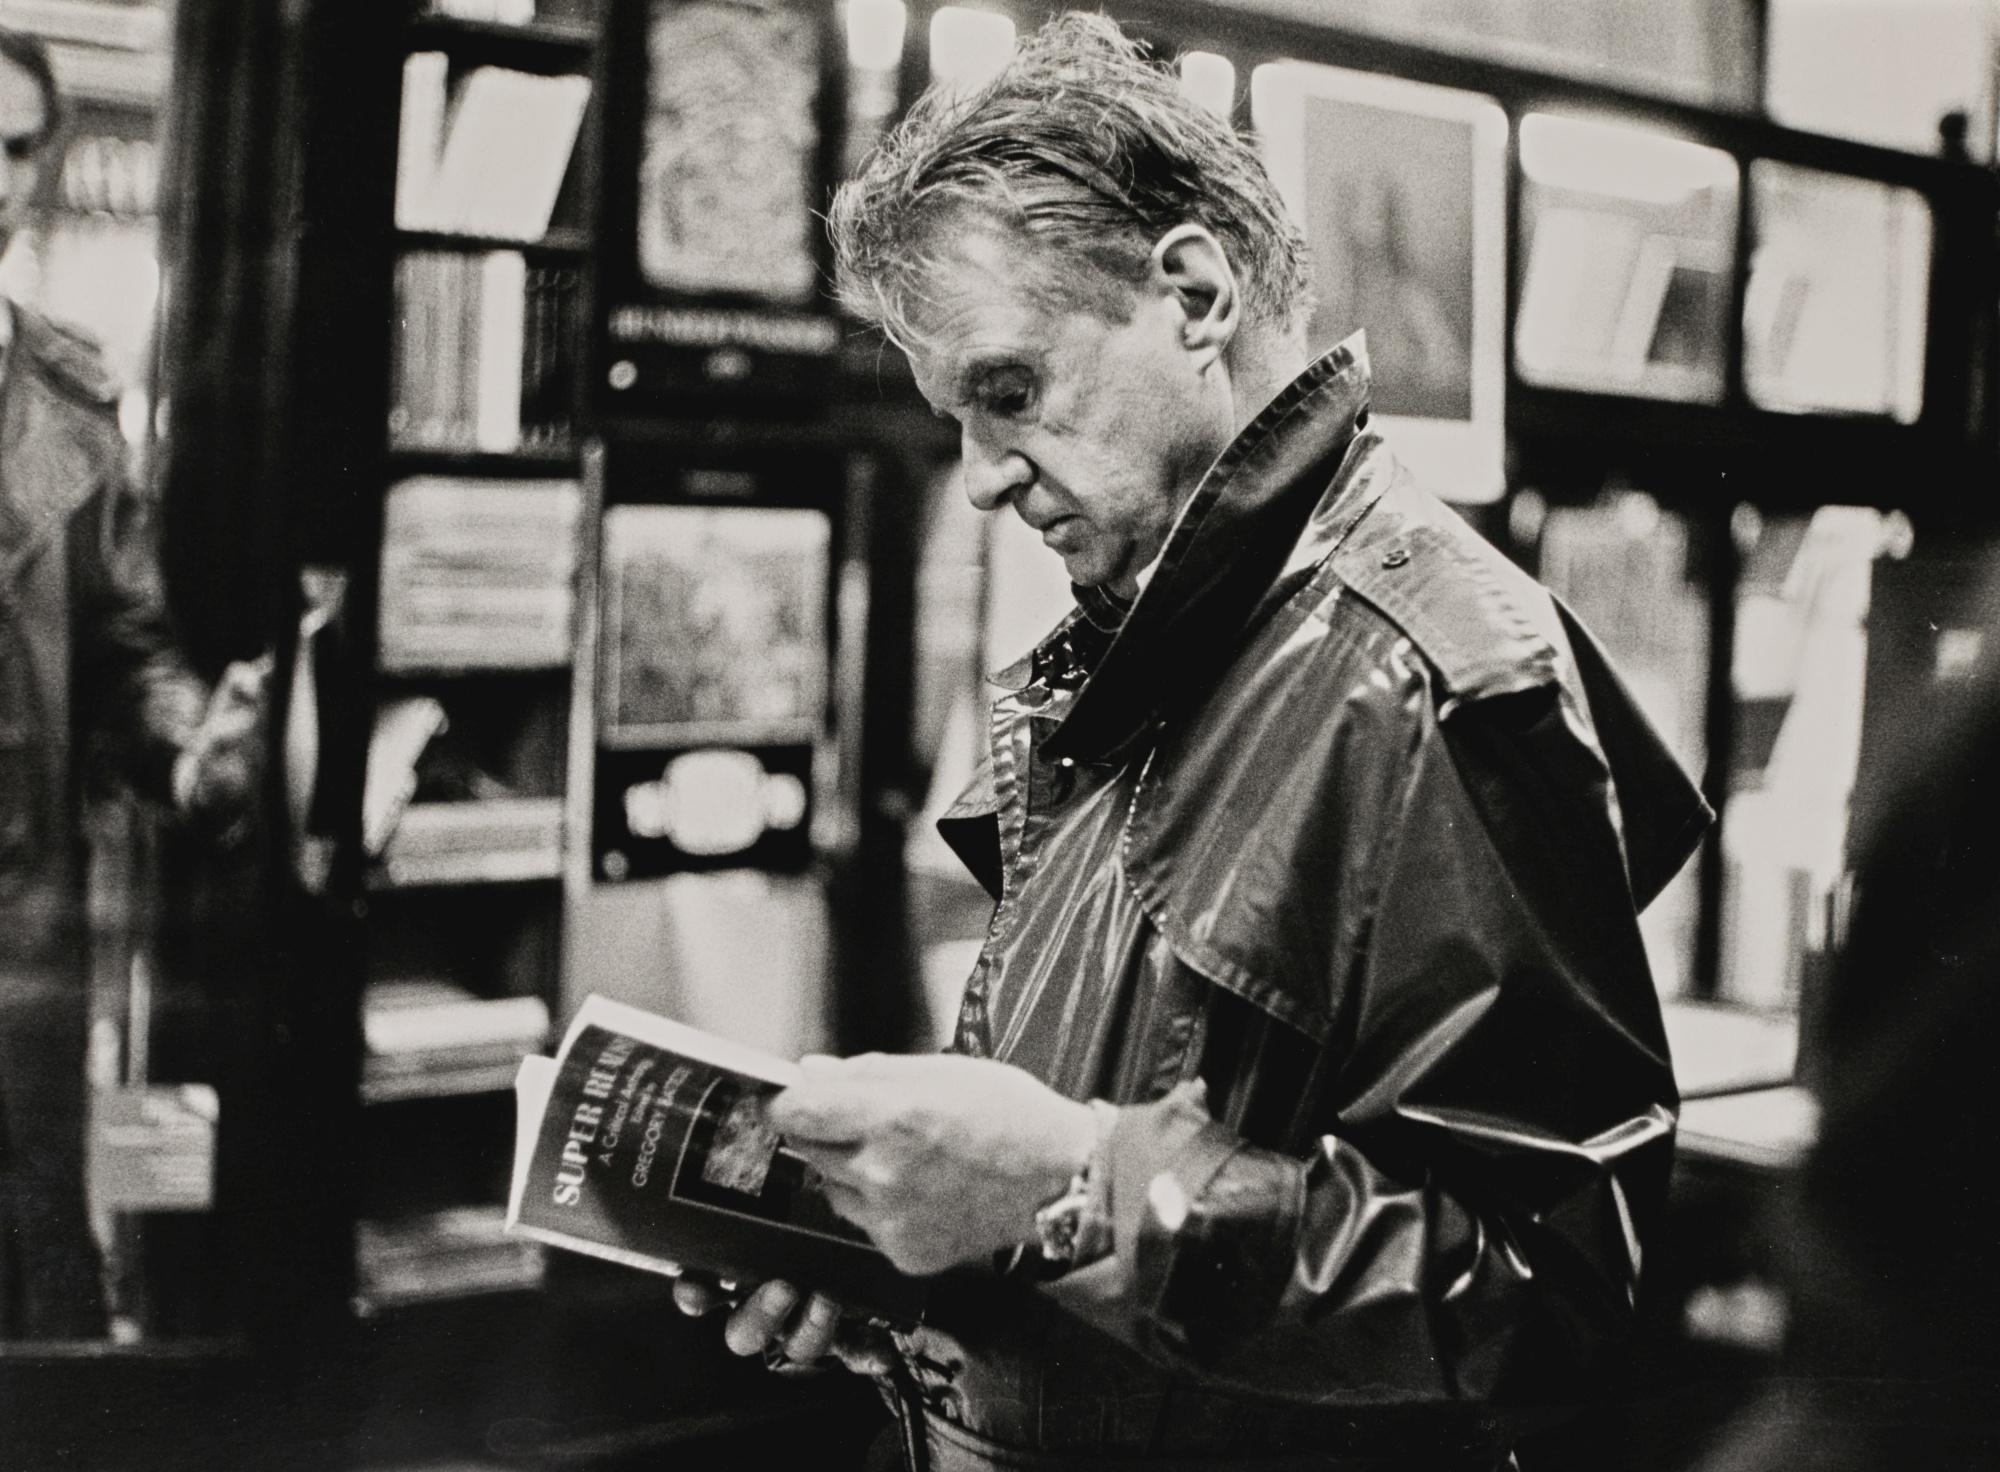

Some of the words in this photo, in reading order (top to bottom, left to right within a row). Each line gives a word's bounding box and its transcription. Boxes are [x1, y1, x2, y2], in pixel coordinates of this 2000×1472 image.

[553, 1102, 604, 1206] SUPER
[582, 1035, 637, 1099] REAL
[599, 1152, 612, 1167] A
[631, 1110, 667, 1188] GREGORY
